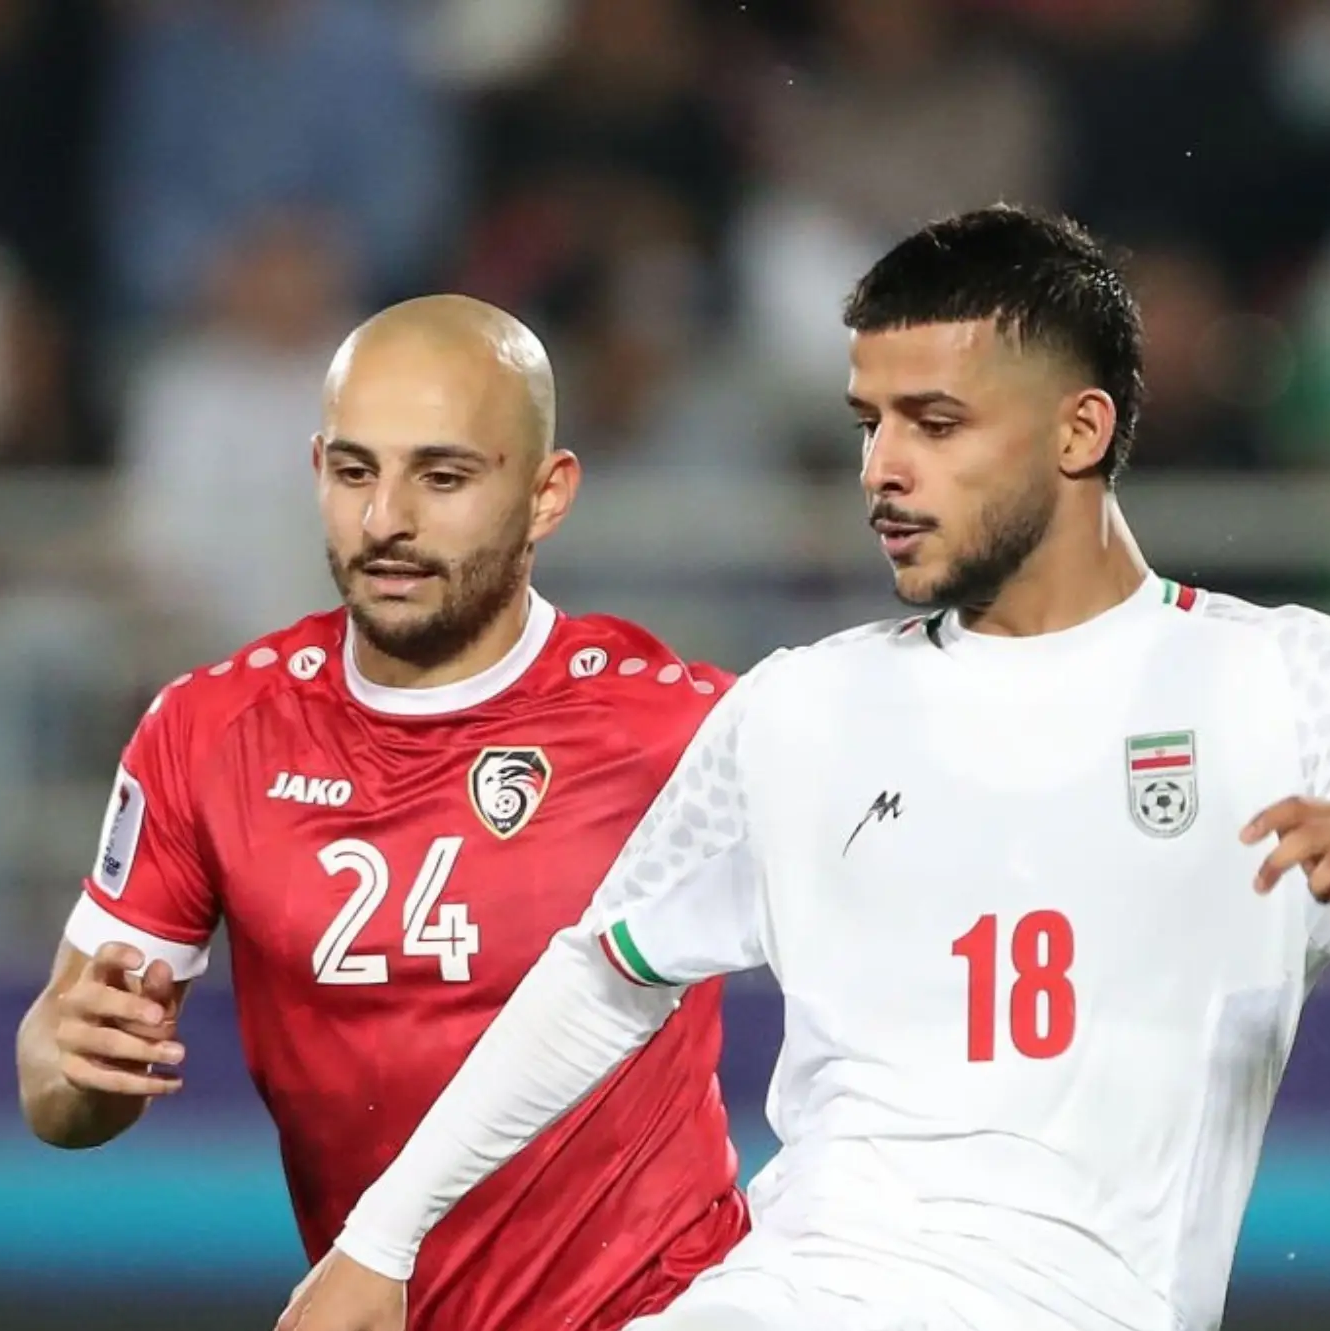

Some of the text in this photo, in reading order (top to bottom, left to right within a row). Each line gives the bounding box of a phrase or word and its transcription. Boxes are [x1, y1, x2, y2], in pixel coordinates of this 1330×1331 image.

[267, 771, 352, 807] JAKO
[312, 837, 479, 984] 24
[951, 909, 1076, 1063] 18
